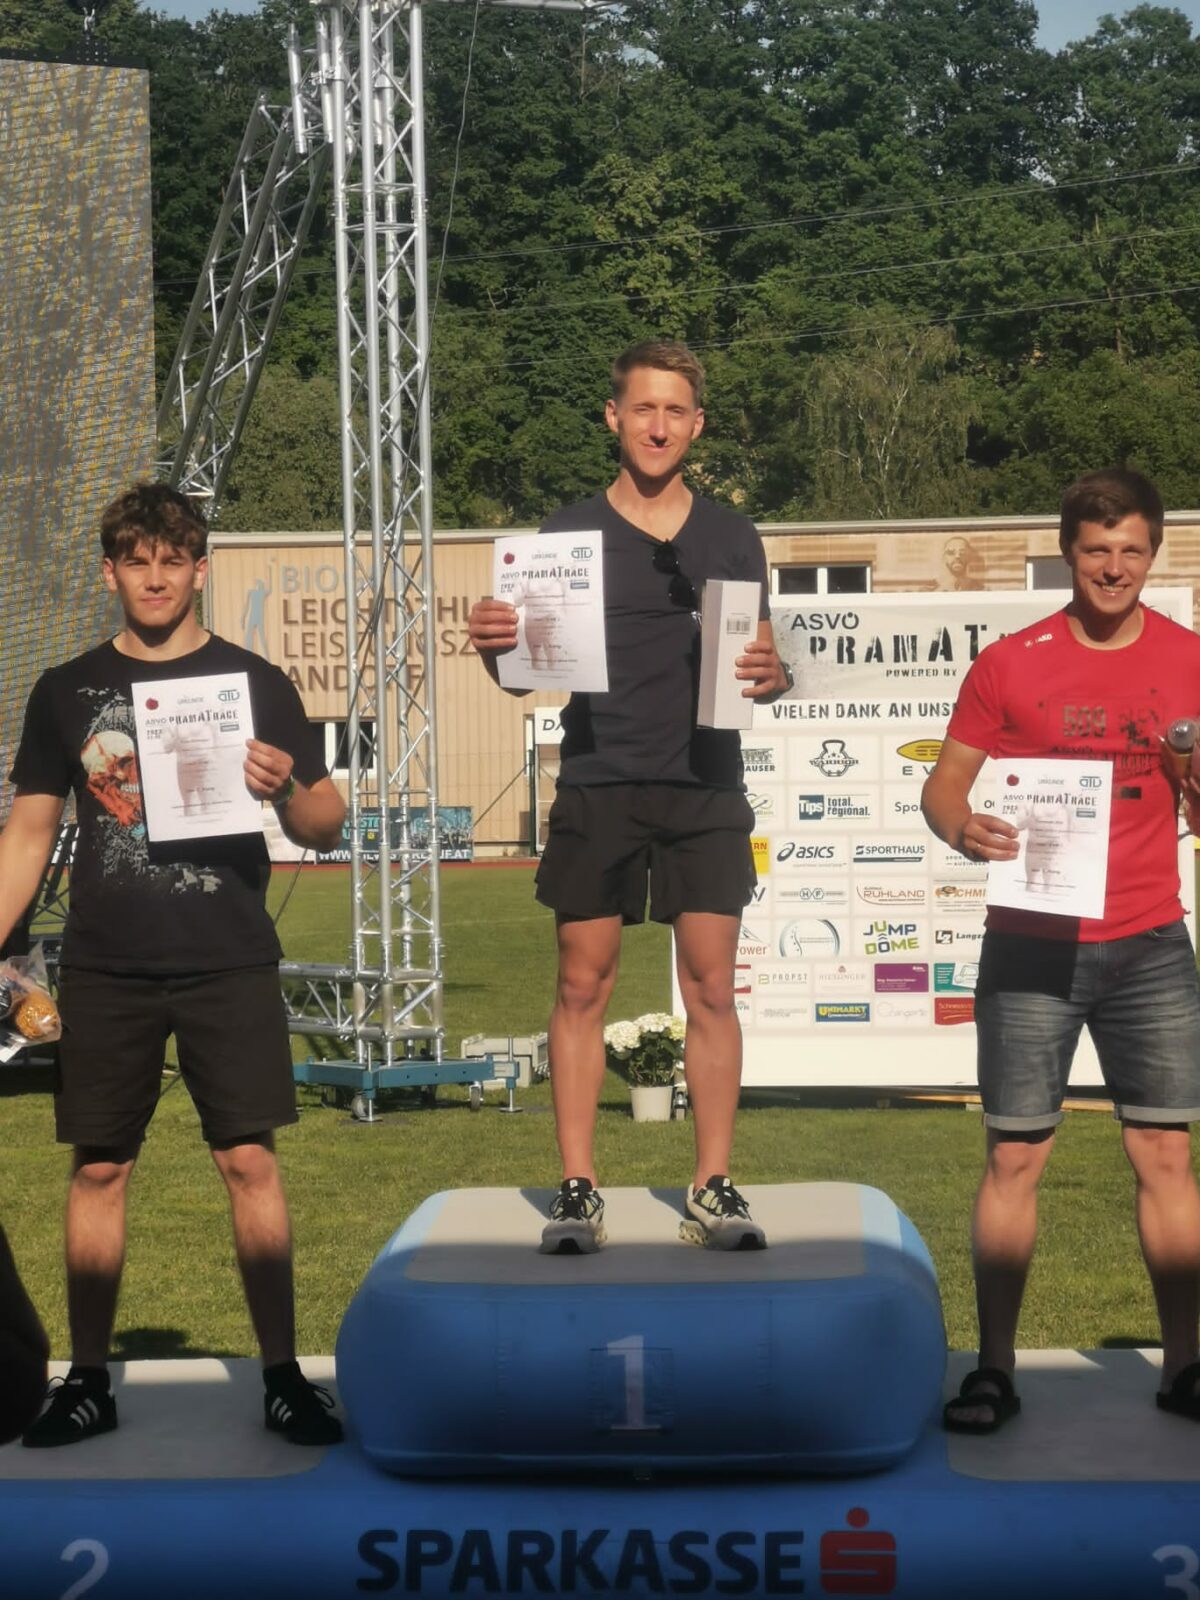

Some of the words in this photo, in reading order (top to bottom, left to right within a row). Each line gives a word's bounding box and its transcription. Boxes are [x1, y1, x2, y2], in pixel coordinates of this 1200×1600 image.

[809, 624, 988, 665] PRAMAT
[886, 669, 938, 677] POWERED
[943, 668, 957, 676] BY
[772, 704, 829, 719] VIELEN
[836, 703, 881, 718] DANK
[888, 703, 912, 717] AN
[918, 702, 957, 717] UNS
[745, 764, 775, 772] AUSER
[799, 802, 823, 814] Tips
[827, 797, 854, 807] total.
[827, 806, 870, 818] regional.
[866, 846, 925, 855] SPORTHAUS
[863, 920, 917, 936] JUMP
[737, 945, 768, 956] ower
[356, 1529, 804, 1594] SPARKASSE
